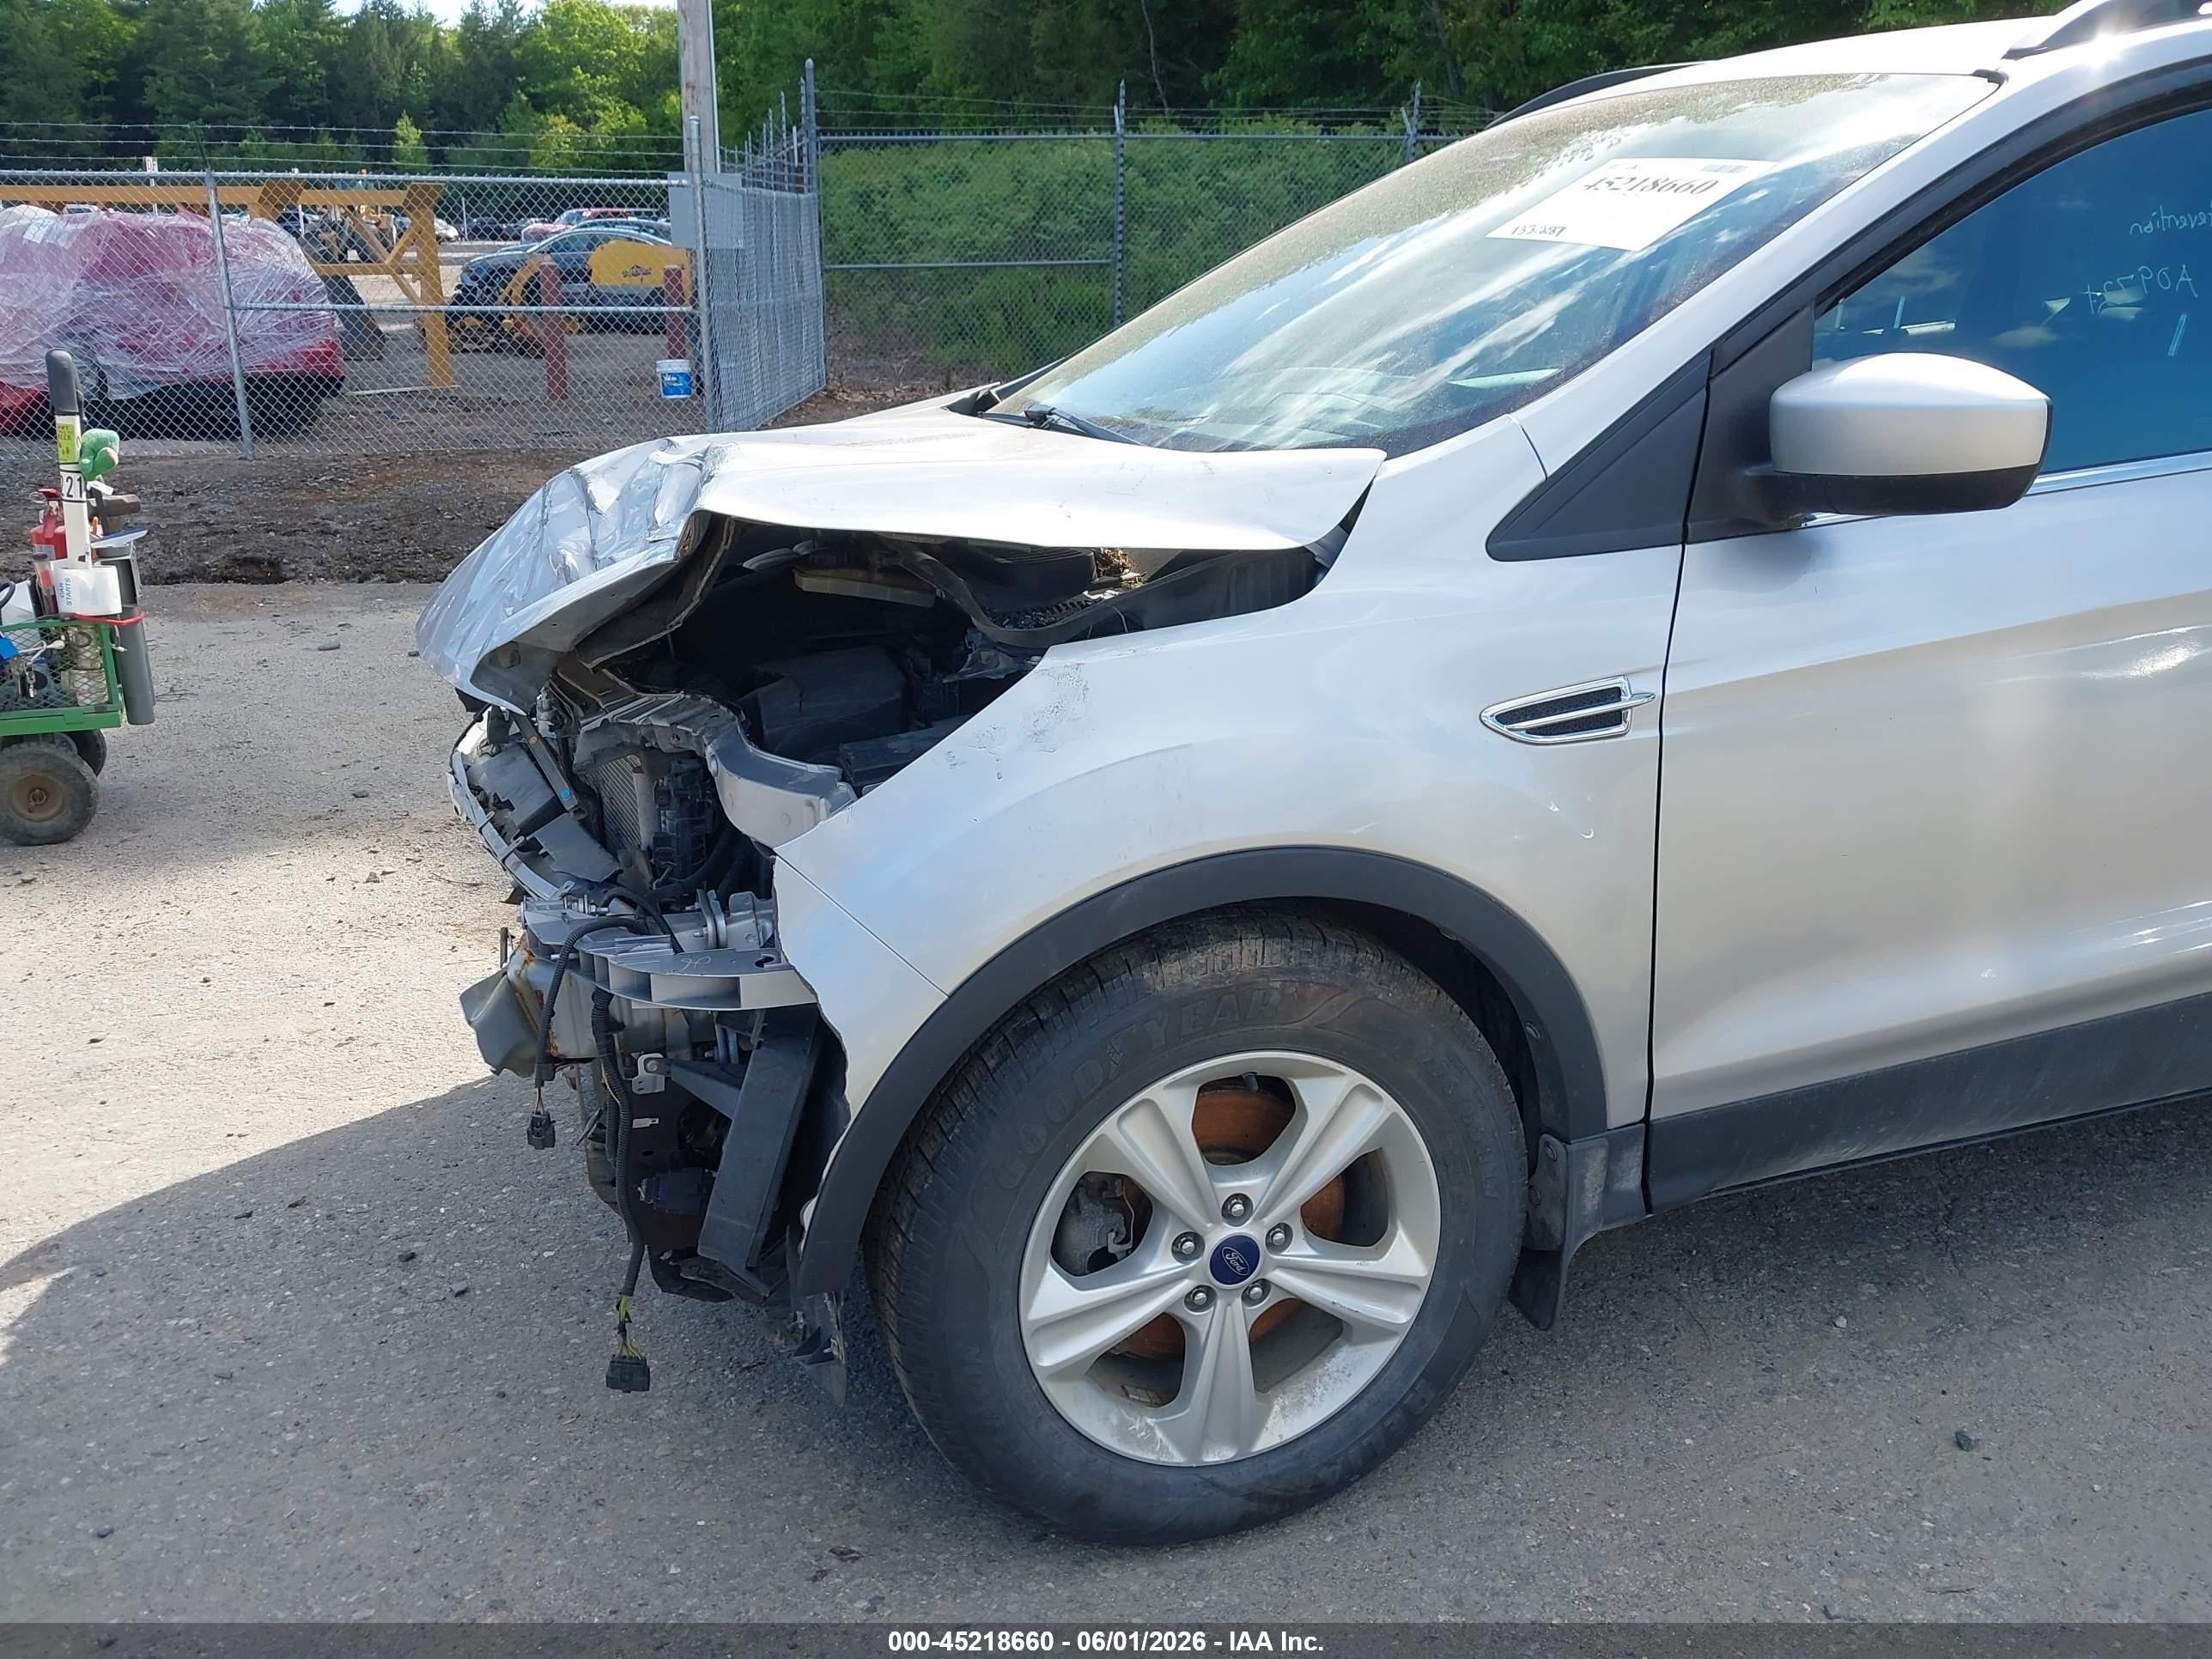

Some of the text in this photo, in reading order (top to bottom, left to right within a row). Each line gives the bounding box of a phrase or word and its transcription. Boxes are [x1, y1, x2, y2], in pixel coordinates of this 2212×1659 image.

[1583, 175, 1719, 195] 45218660
[64, 577, 73, 606] STARTS
[993, 986, 1286, 1190] GOODYEAR
[1224, 1251, 1248, 1273] Ford
